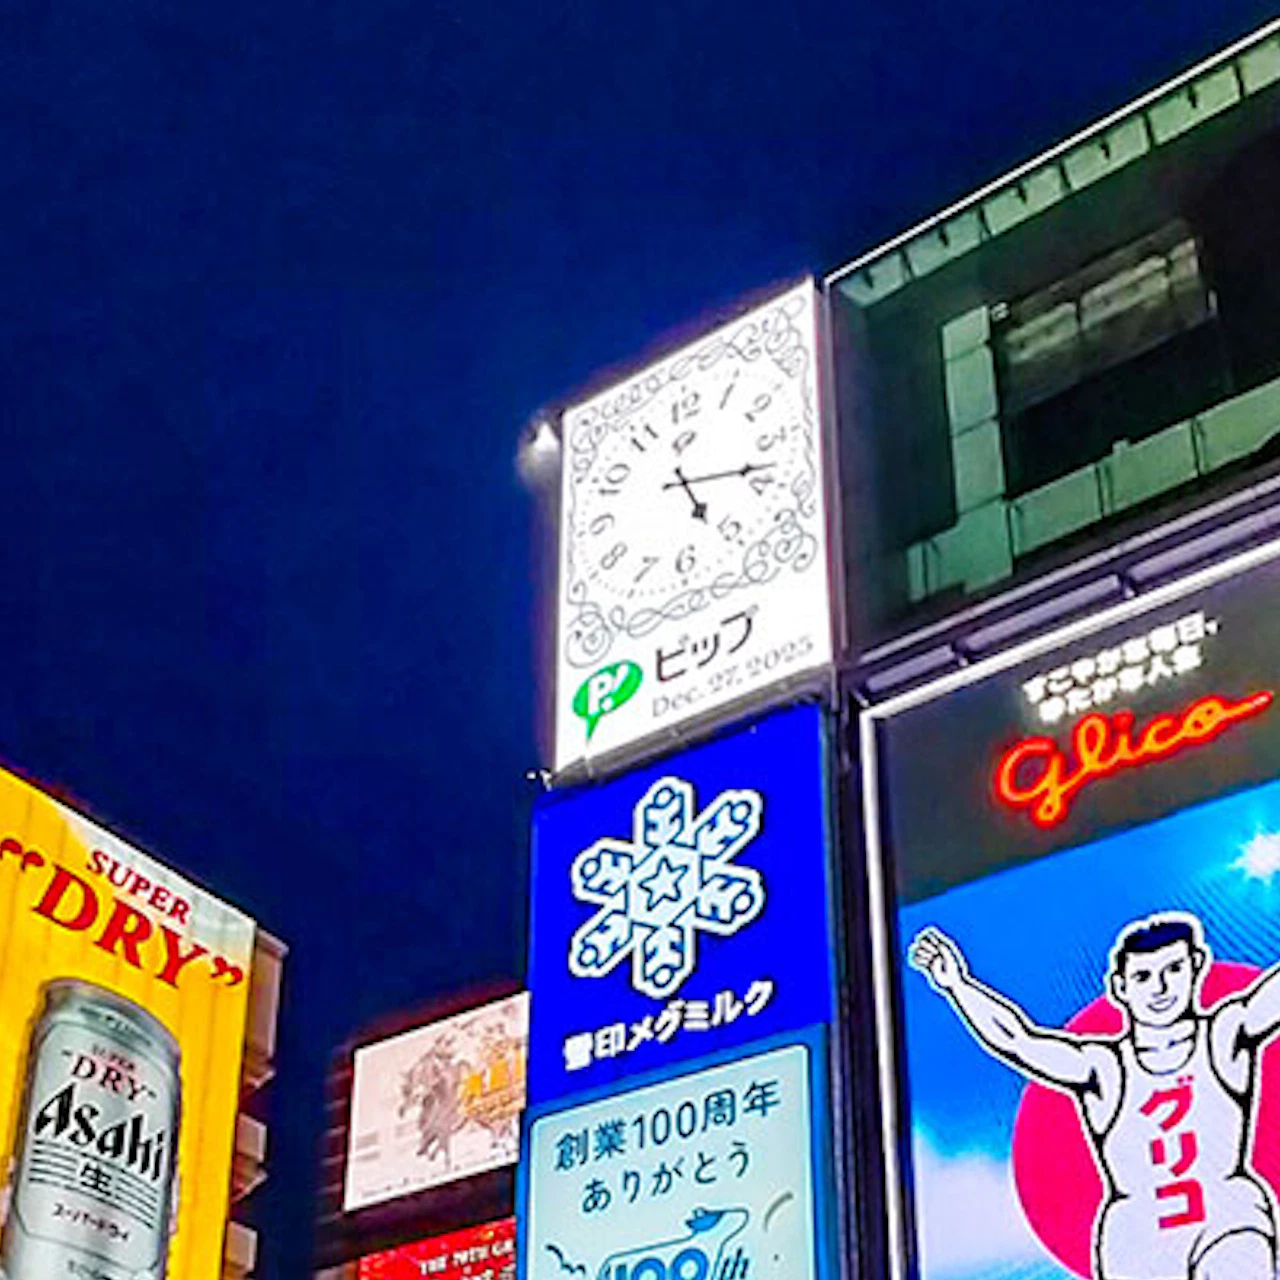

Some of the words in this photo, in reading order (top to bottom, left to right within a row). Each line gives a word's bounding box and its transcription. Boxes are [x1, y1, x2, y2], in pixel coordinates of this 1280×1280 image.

[671, 392, 700, 424] 12
[719, 381, 735, 410] 1
[745, 394, 771, 423] 2
[631, 423, 659, 453] 11
[757, 431, 778, 452] 3
[599, 463, 631, 496] 10
[748, 475, 774, 496] 4
[589, 513, 615, 536] 9
[717, 515, 742, 542] 5
[600, 543, 628, 571] 8
[634, 557, 659, 583] 7
[675, 546, 696, 573] 6
[655, 604, 760, 682] ピップ
[744, 634, 814, 679] 2025
[86, 849, 192, 925] SUPER
[563, 981, 773, 1071] 雪印メグミルク
[34, 1082, 167, 1181] Asahi
[555, 1080, 781, 1171] 創業100周年
[1139, 1075, 1206, 1229] グリコ
[80, 1163, 112, 1197] 生
[581, 1142, 750, 1213] ありがとう
